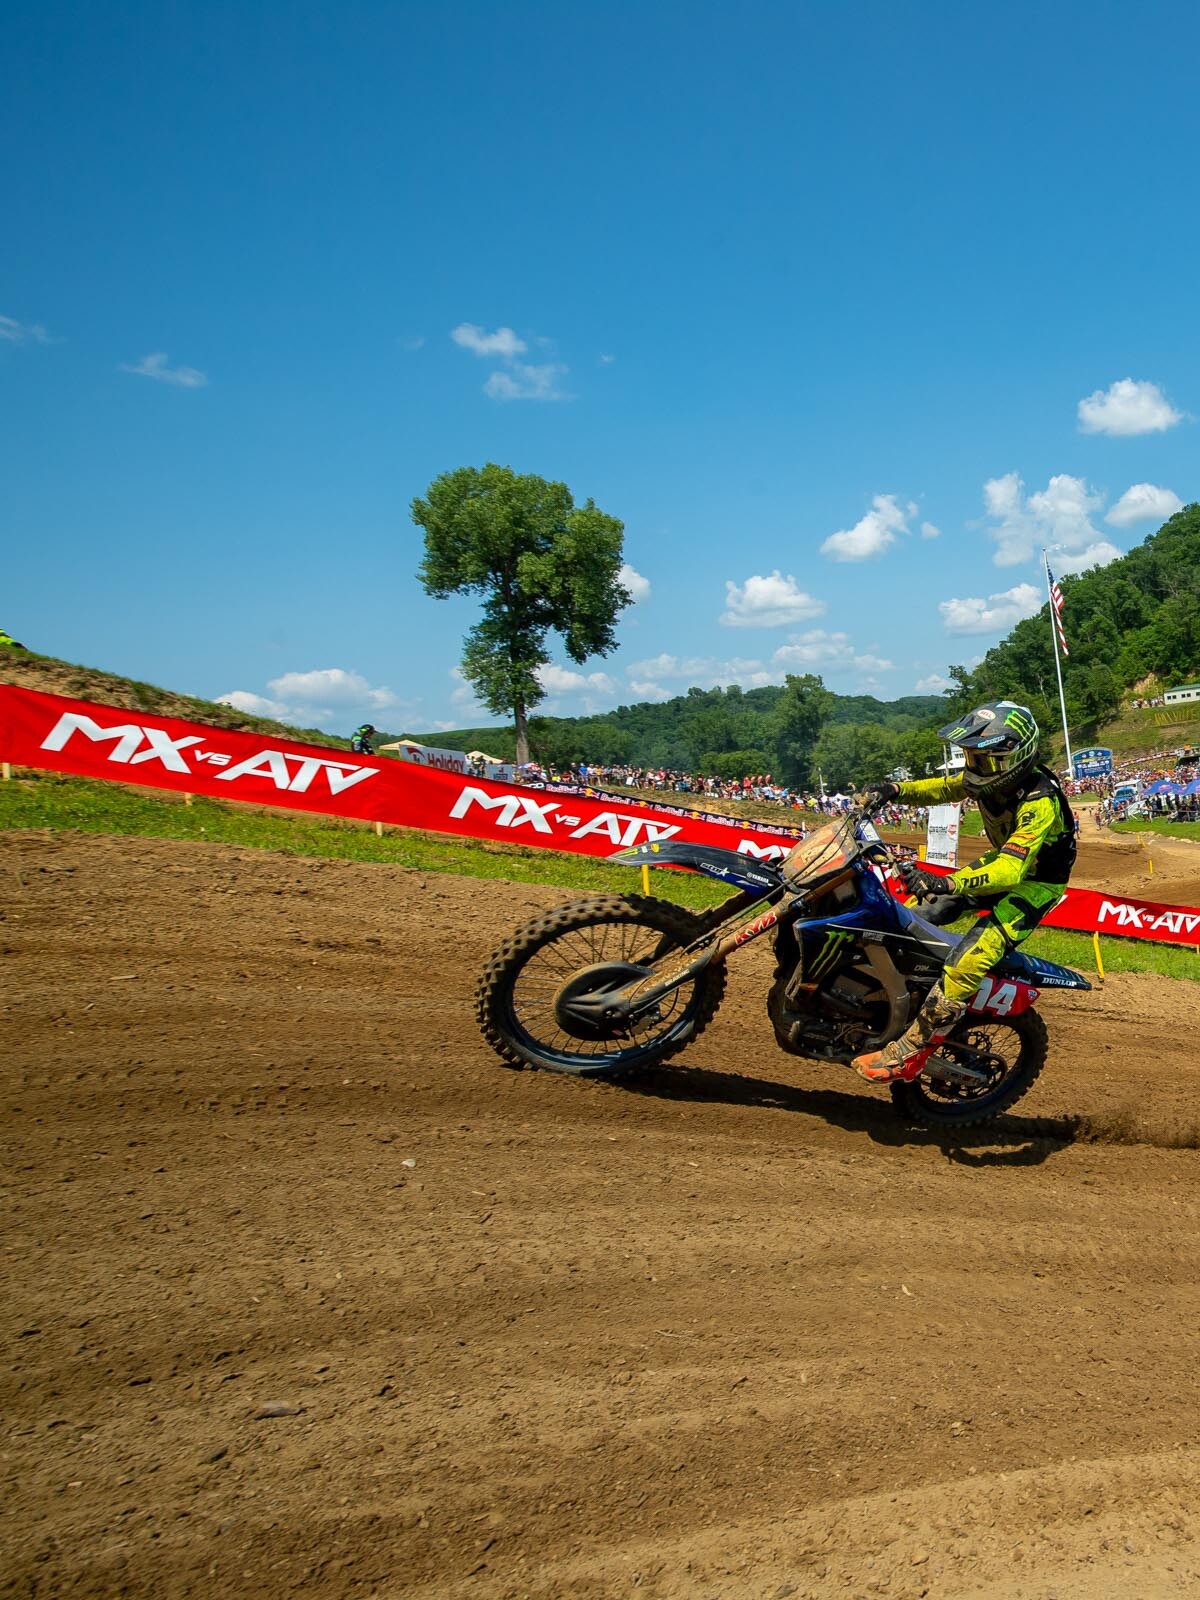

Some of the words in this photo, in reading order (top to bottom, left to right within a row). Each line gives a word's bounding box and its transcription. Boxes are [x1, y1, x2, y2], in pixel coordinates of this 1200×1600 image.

[40, 712, 206, 774] MX
[214, 749, 381, 795] ATV
[449, 786, 562, 834] MX
[569, 812, 683, 847] ATV
[1097, 900, 1147, 928] MX
[971, 977, 1017, 1016] 14
[1042, 977, 1077, 987] DUNLOP
